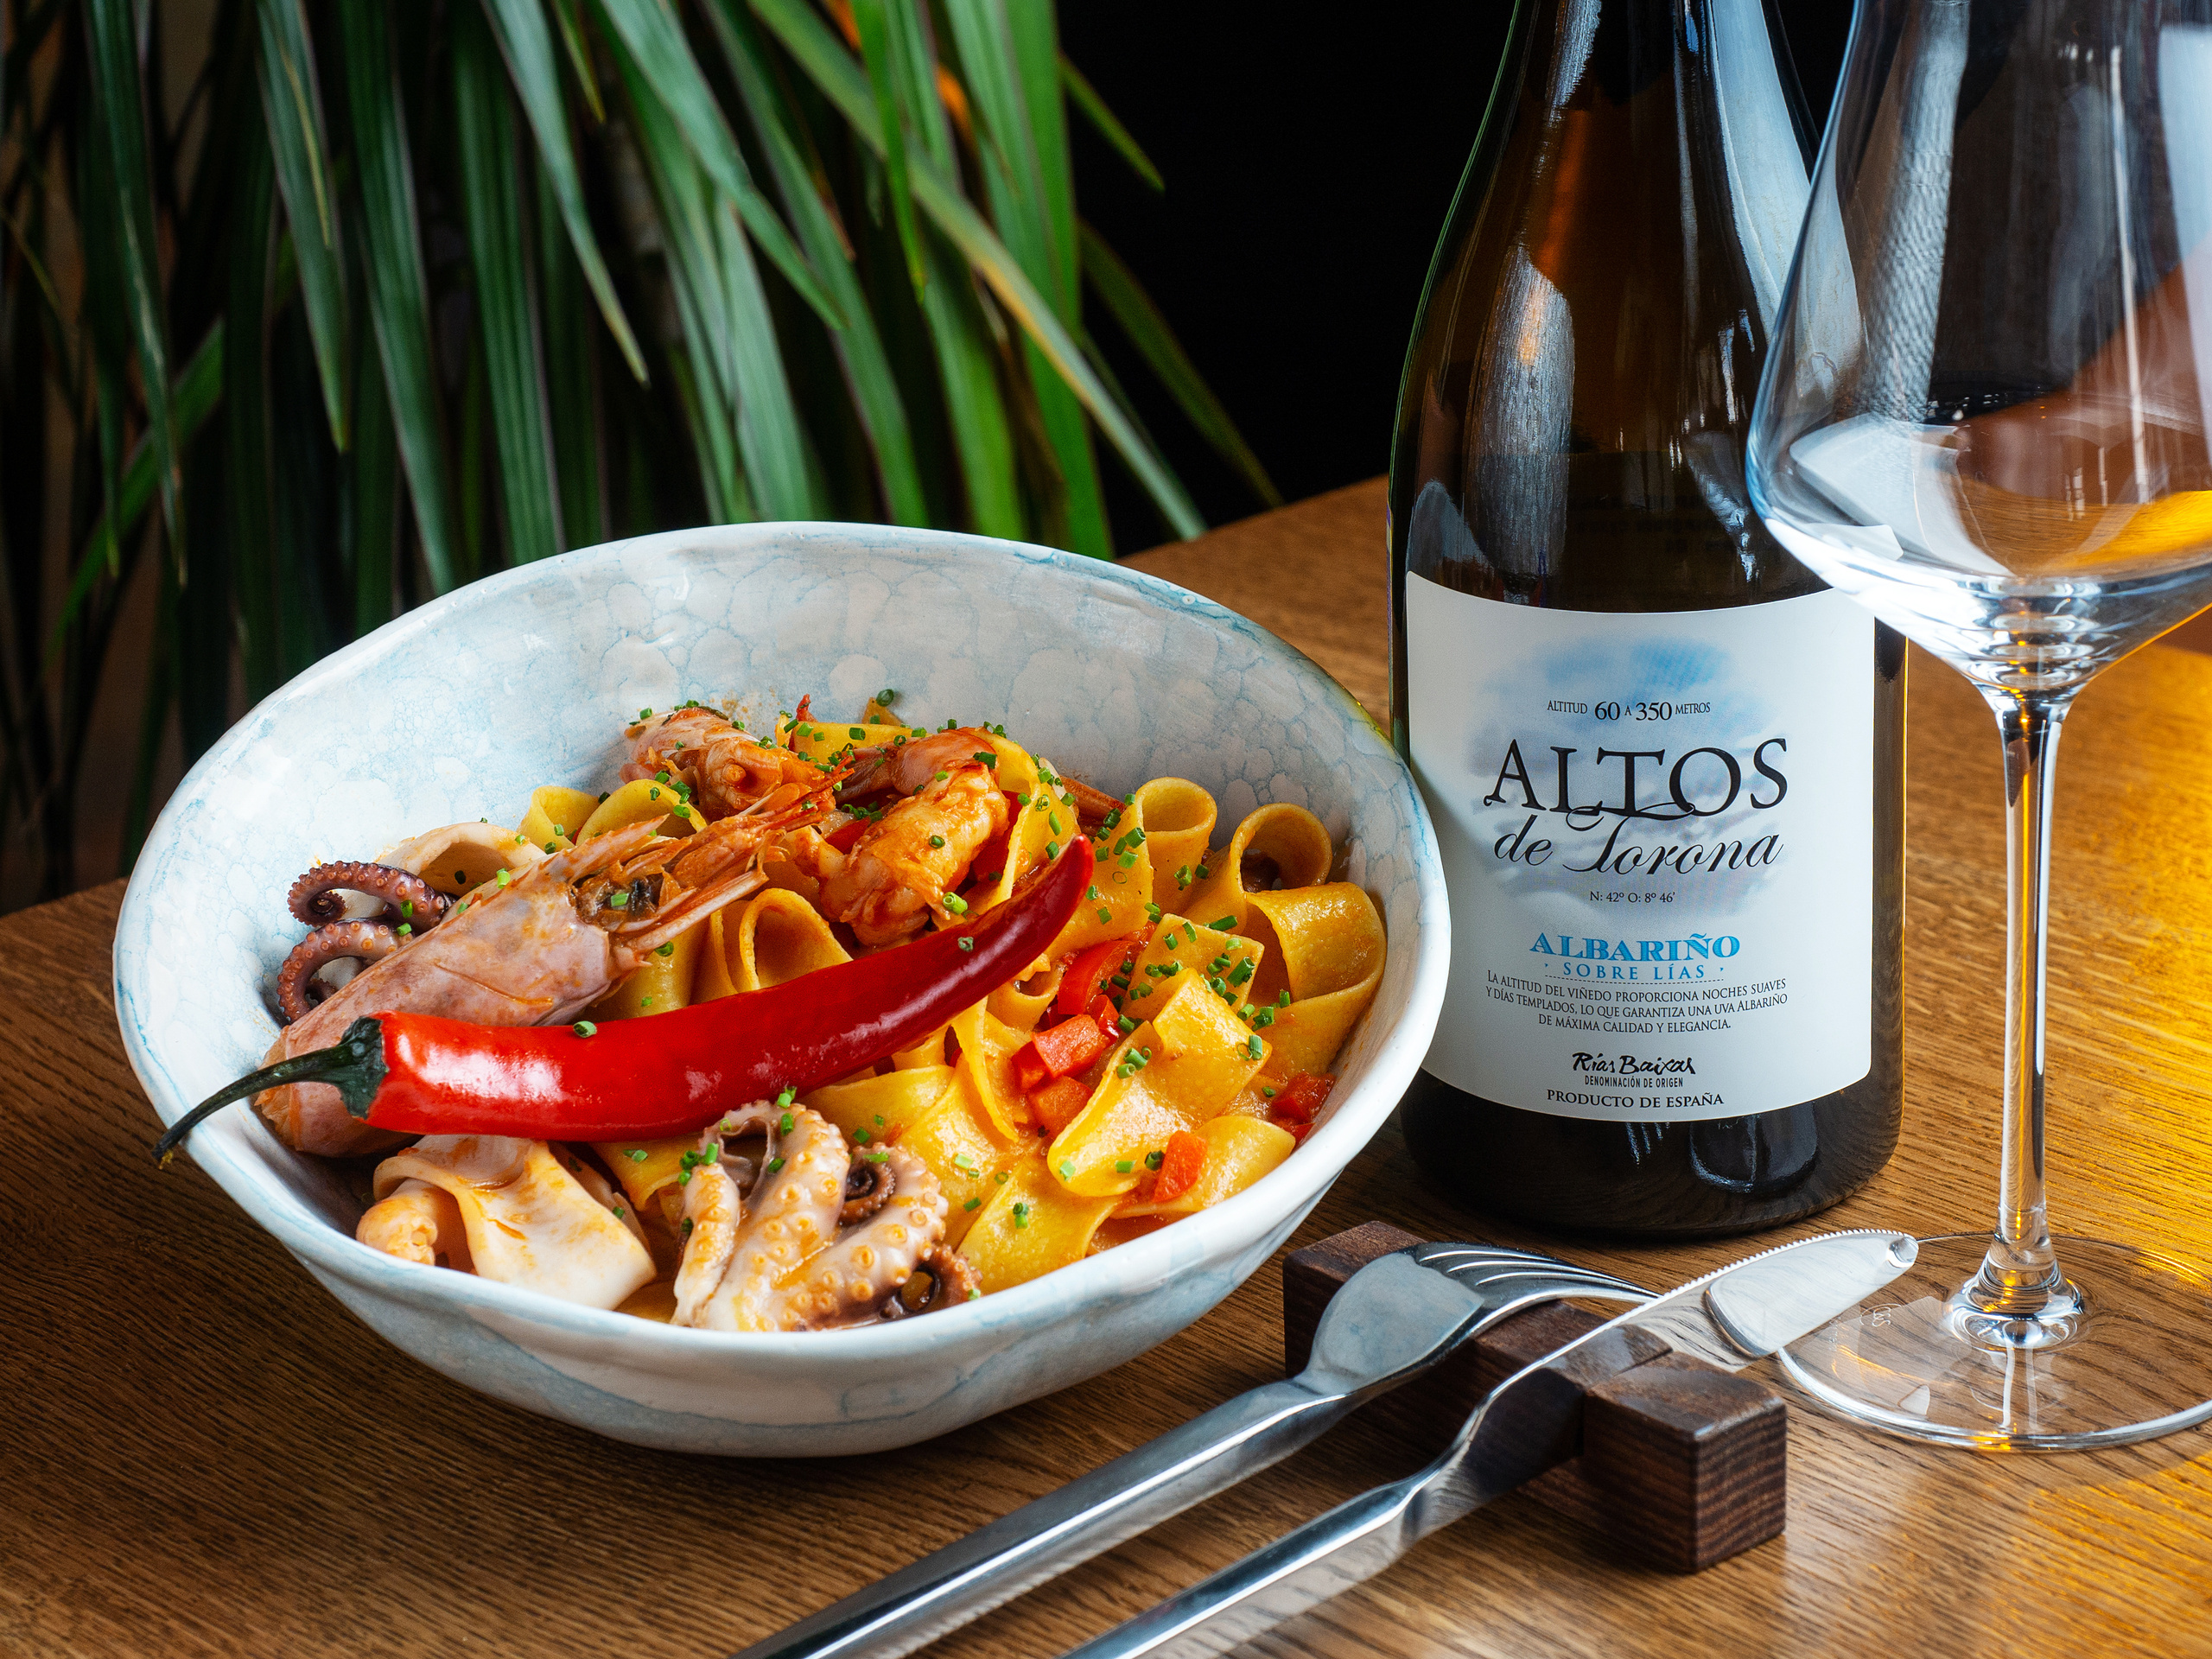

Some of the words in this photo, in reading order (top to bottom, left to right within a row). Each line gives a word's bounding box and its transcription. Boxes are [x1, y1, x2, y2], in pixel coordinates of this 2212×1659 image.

[1547, 699, 1588, 715] ALTITUD
[1594, 701, 1621, 721] 60
[1624, 704, 1632, 716] A
[1635, 702, 1673, 721] 350
[1675, 702, 1711, 715] METROS
[1483, 737, 1789, 817] ALTOS
[1494, 813, 1554, 867] de
[1562, 802, 1784, 875] Torona
[1590, 890, 1603, 901] N:
[1627, 892, 1642, 904] O:
[1529, 932, 1741, 963] ALBARIÑO
[1563, 962, 1638, 981] SOBRE
[1653, 963, 1706, 981] LÍAS
[1500, 976, 1542, 994] ALTITUD
[1545, 984, 1566, 997] DEL
[1567, 986, 1612, 1001] VIÑEDO
[1615, 990, 1700, 1003] PROPORCIONA
[1702, 985, 1748, 1001] NOCHES
[1751, 977, 1787, 995] SUAVES
[1485, 985, 1493, 997] Y
[1493, 987, 1515, 1003] DÍAS
[1516, 994, 1578, 1015] TEMPLADOS,
[1580, 1004, 1595, 1016] LO
[1597, 1005, 1620, 1020] QUE
[1622, 1007, 1686, 1018] GARANTIZA
[1688, 1005, 1713, 1017] UNA
[1714, 1002, 1736, 1014] UVA
[1736, 993, 1789, 1013] ALBARIÑO
[1538, 1013, 1553, 1026] DE
[1554, 1015, 1601, 1032] MÁXIMA
[1603, 1020, 1654, 1033] CALIDAD
[1656, 1022, 1664, 1033] Y
[1667, 1019, 1732, 1033] ELEGANCIA.
[1572, 1052, 1616, 1074] Rías
[1618, 1055, 1696, 1076] Baixas
[1585, 1075, 1641, 1089] DENOMINACIÓN
[1643, 1077, 1653, 1089] DE
[1656, 1077, 1683, 1089] ORIGEN
[1547, 1089, 1635, 1109] PRODUCTO
[1639, 1096, 1661, 1109] DE
[1665, 1091, 1725, 1109] ESPAÑA
